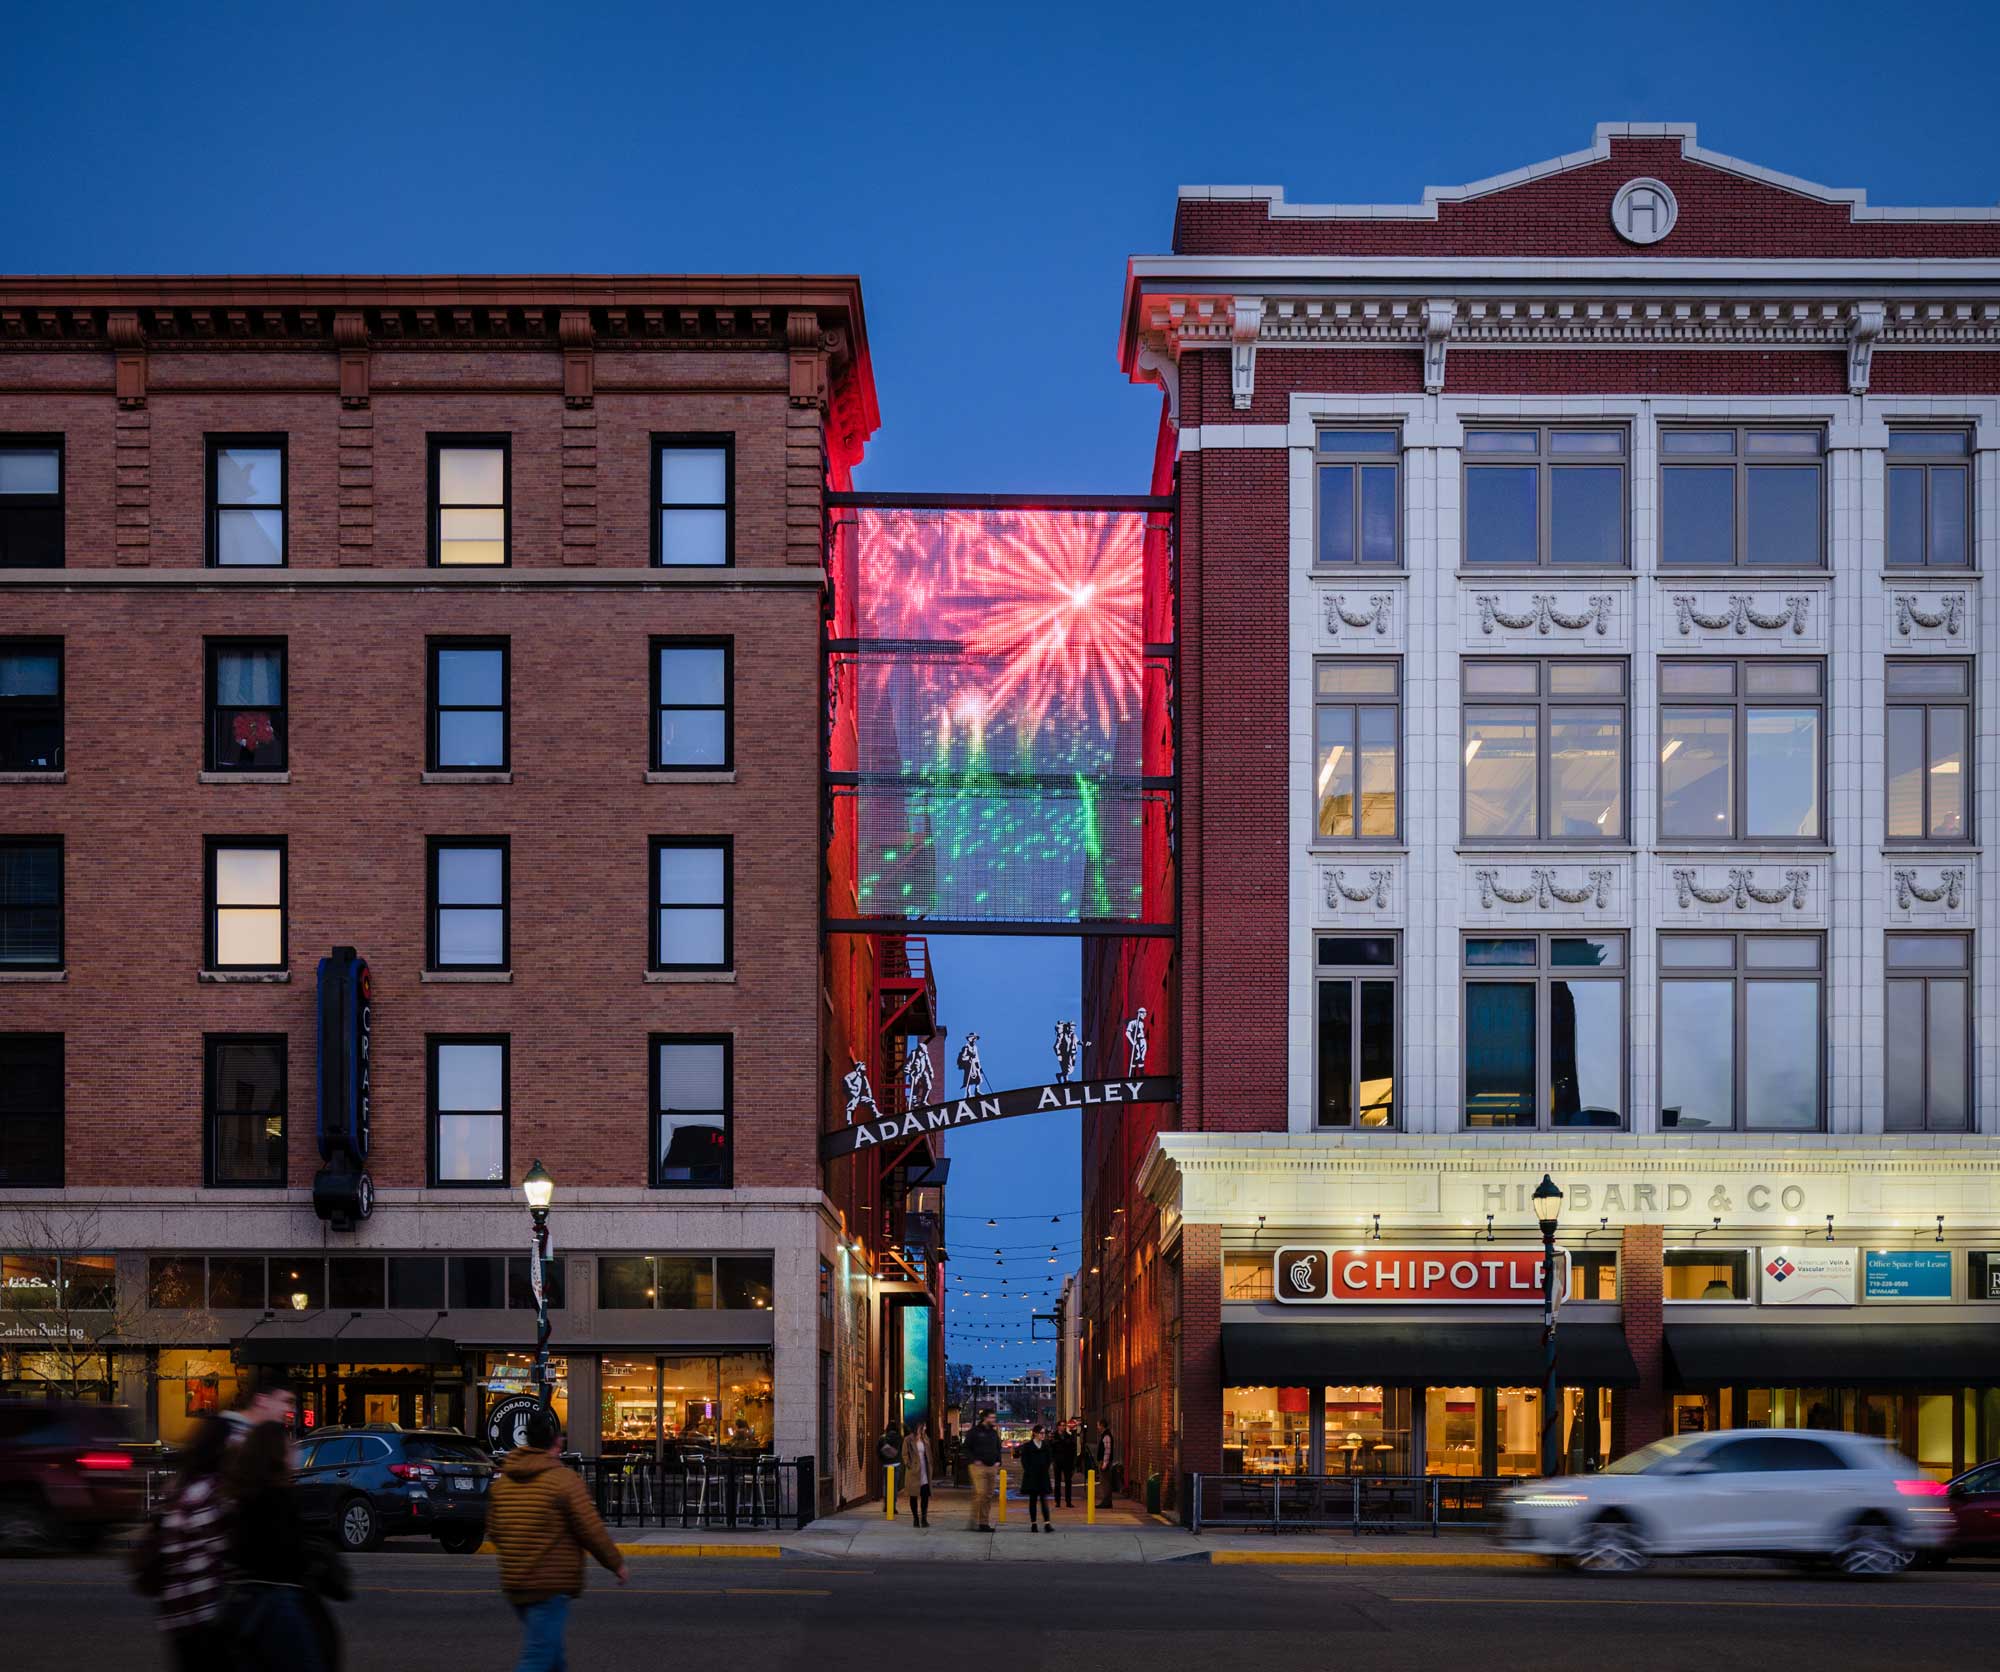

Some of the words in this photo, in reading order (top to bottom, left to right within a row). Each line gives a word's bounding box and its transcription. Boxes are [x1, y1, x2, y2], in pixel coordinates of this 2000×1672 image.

[1628, 195, 1657, 233] H
[361, 1006, 371, 1152] CRAFT
[854, 1098, 1001, 1149] ADAMAN
[1038, 1081, 1144, 1109] ALLEY
[1482, 1183, 1692, 1212] HIBARD
[1707, 1183, 1733, 1212] &
[1747, 1184, 1805, 1212] CO
[1868, 1260, 1891, 1268] Office
[1892, 1260, 1913, 1270] Space
[1914, 1260, 1925, 1268] for
[1927, 1260, 1947, 1268] Lease
[0, 1322, 37, 1336] Carlton
[39, 1322, 84, 1339] Buildng
[493, 1401, 531, 1423] COLORADO
